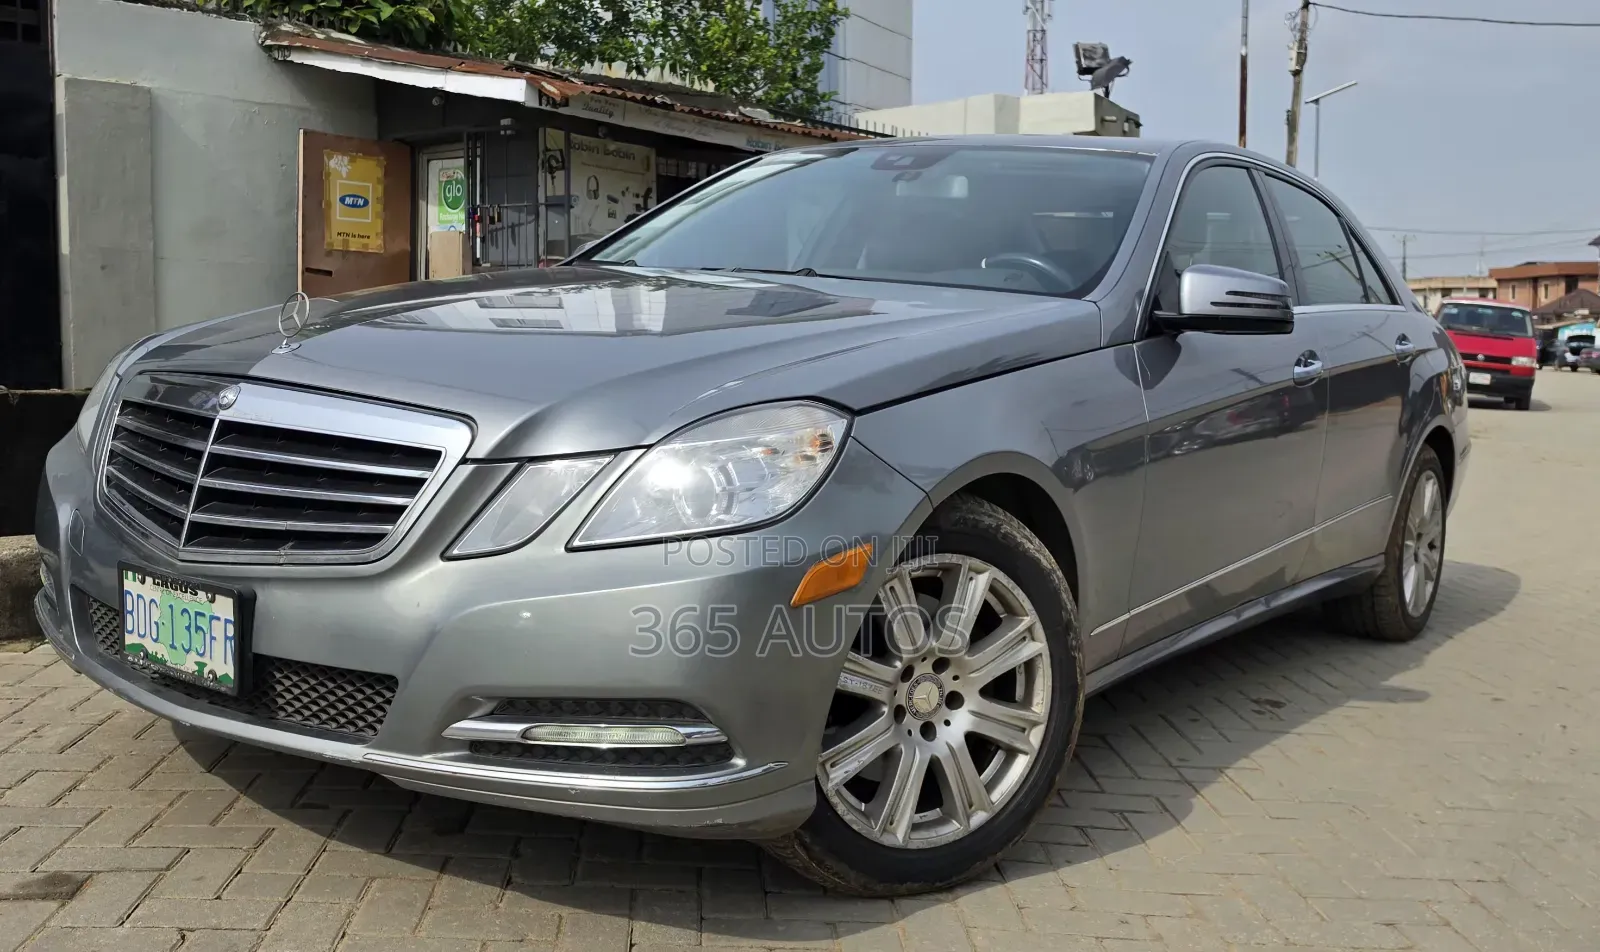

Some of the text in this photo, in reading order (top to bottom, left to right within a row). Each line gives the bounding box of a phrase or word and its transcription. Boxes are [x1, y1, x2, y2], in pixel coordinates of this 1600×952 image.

[582, 102, 615, 119] Quality
[445, 181, 463, 203] glo
[344, 196, 365, 207] MTN
